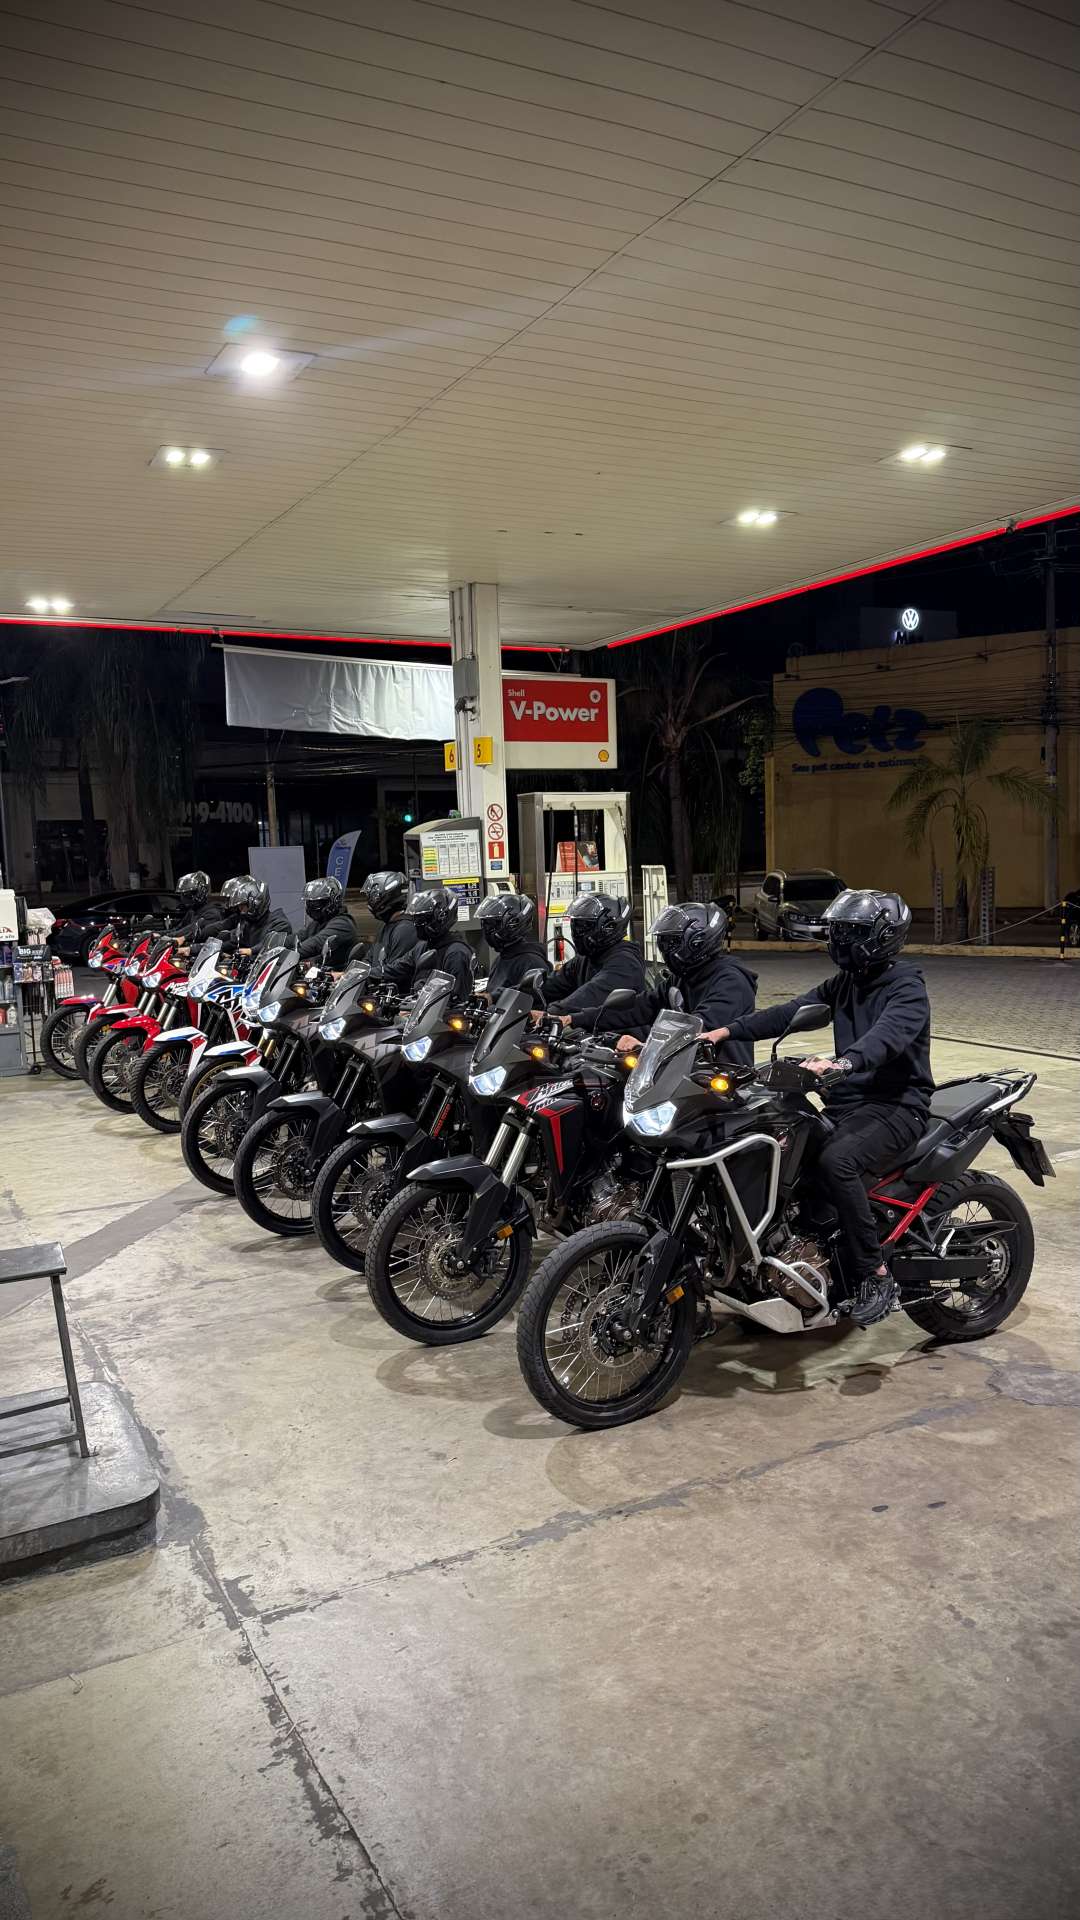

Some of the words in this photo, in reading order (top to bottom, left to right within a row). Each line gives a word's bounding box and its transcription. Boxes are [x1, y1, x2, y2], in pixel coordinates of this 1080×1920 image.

[508, 689, 525, 697] Shell
[509, 700, 599, 721] V-Power
[792, 687, 927, 757] Petz
[449, 749, 455, 763] 6
[476, 743, 482, 758] 5
